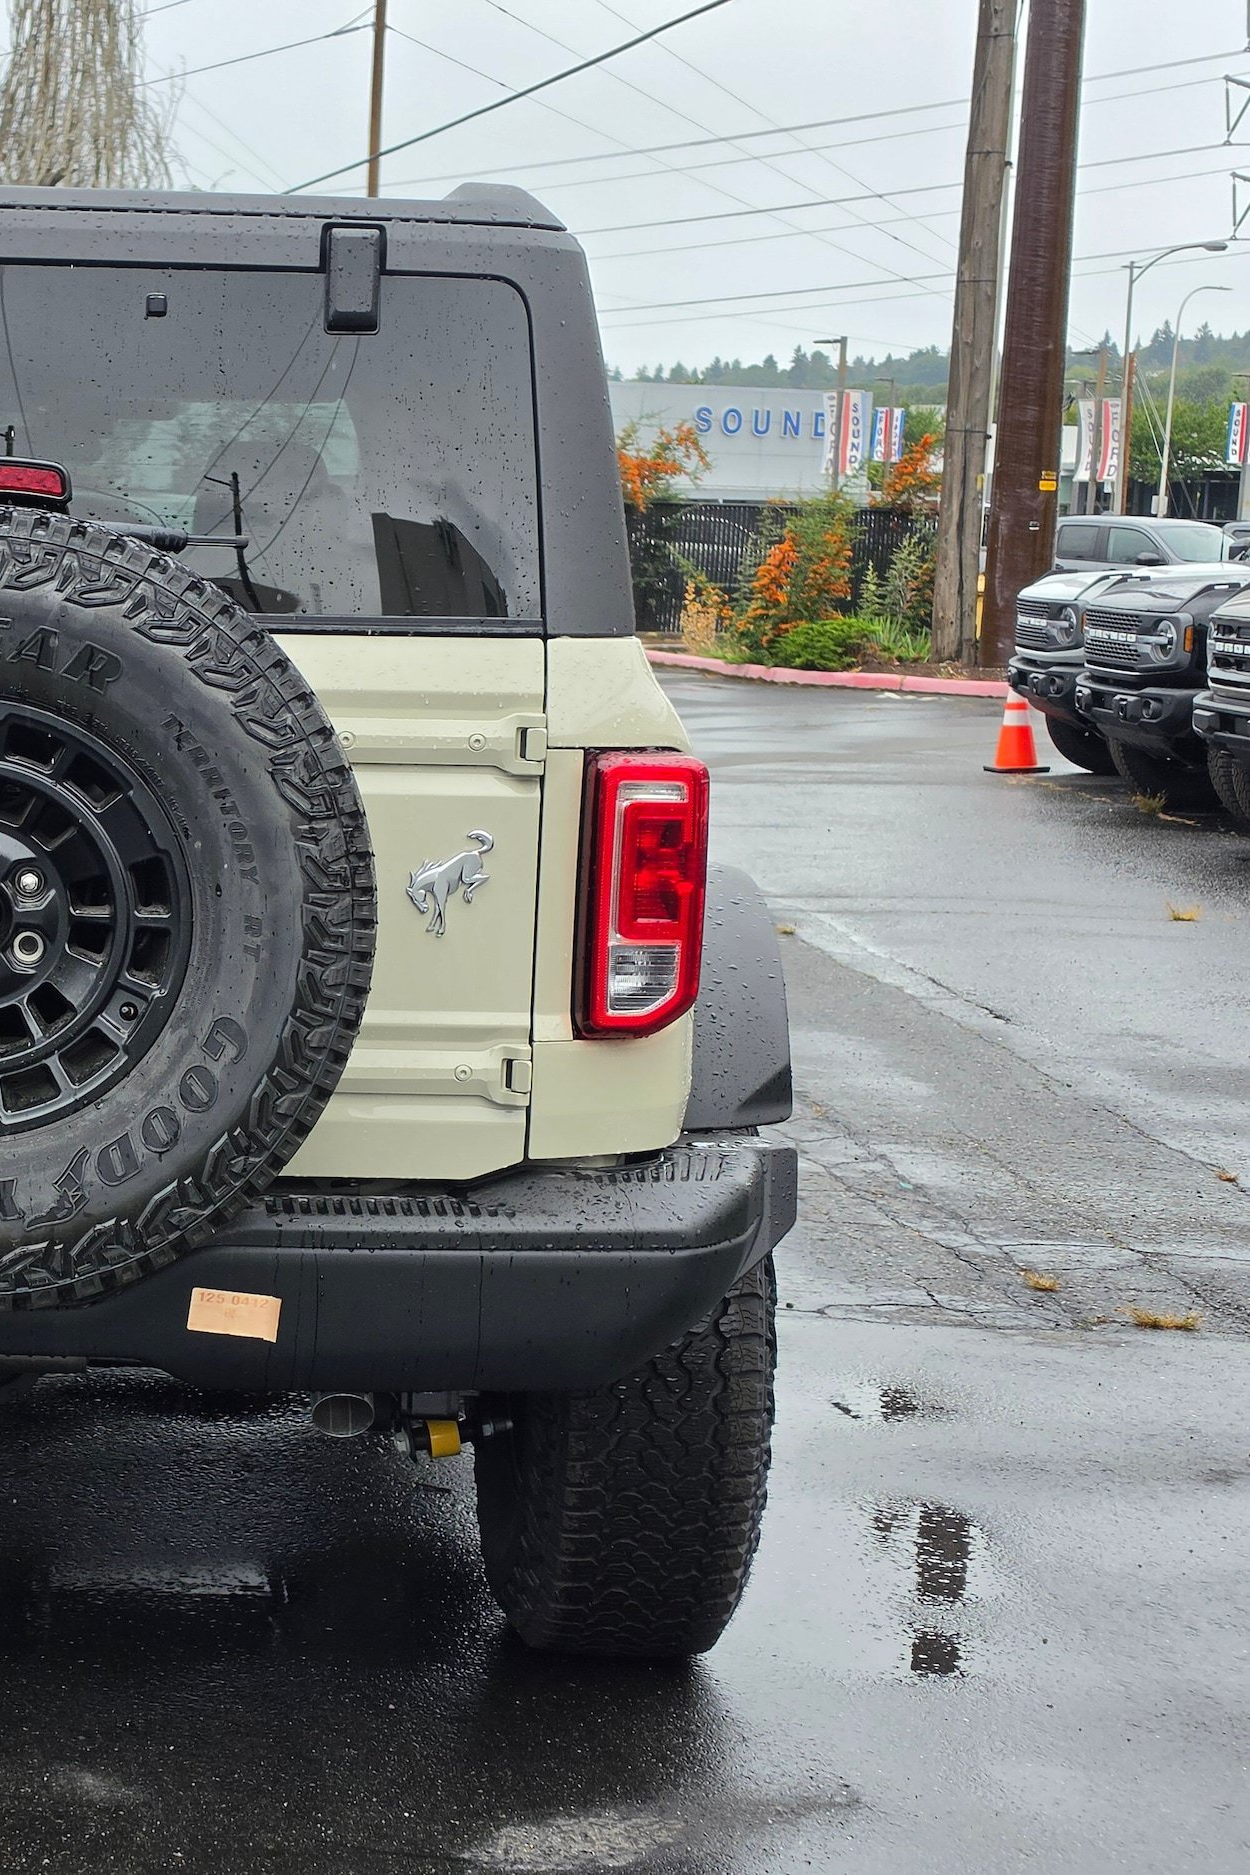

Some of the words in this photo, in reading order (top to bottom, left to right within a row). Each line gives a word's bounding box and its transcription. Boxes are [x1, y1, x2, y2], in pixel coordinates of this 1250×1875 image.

[849, 403, 860, 464] SOUND
[160, 712, 260, 885] TERRITORY
[243, 914, 263, 962] RT
